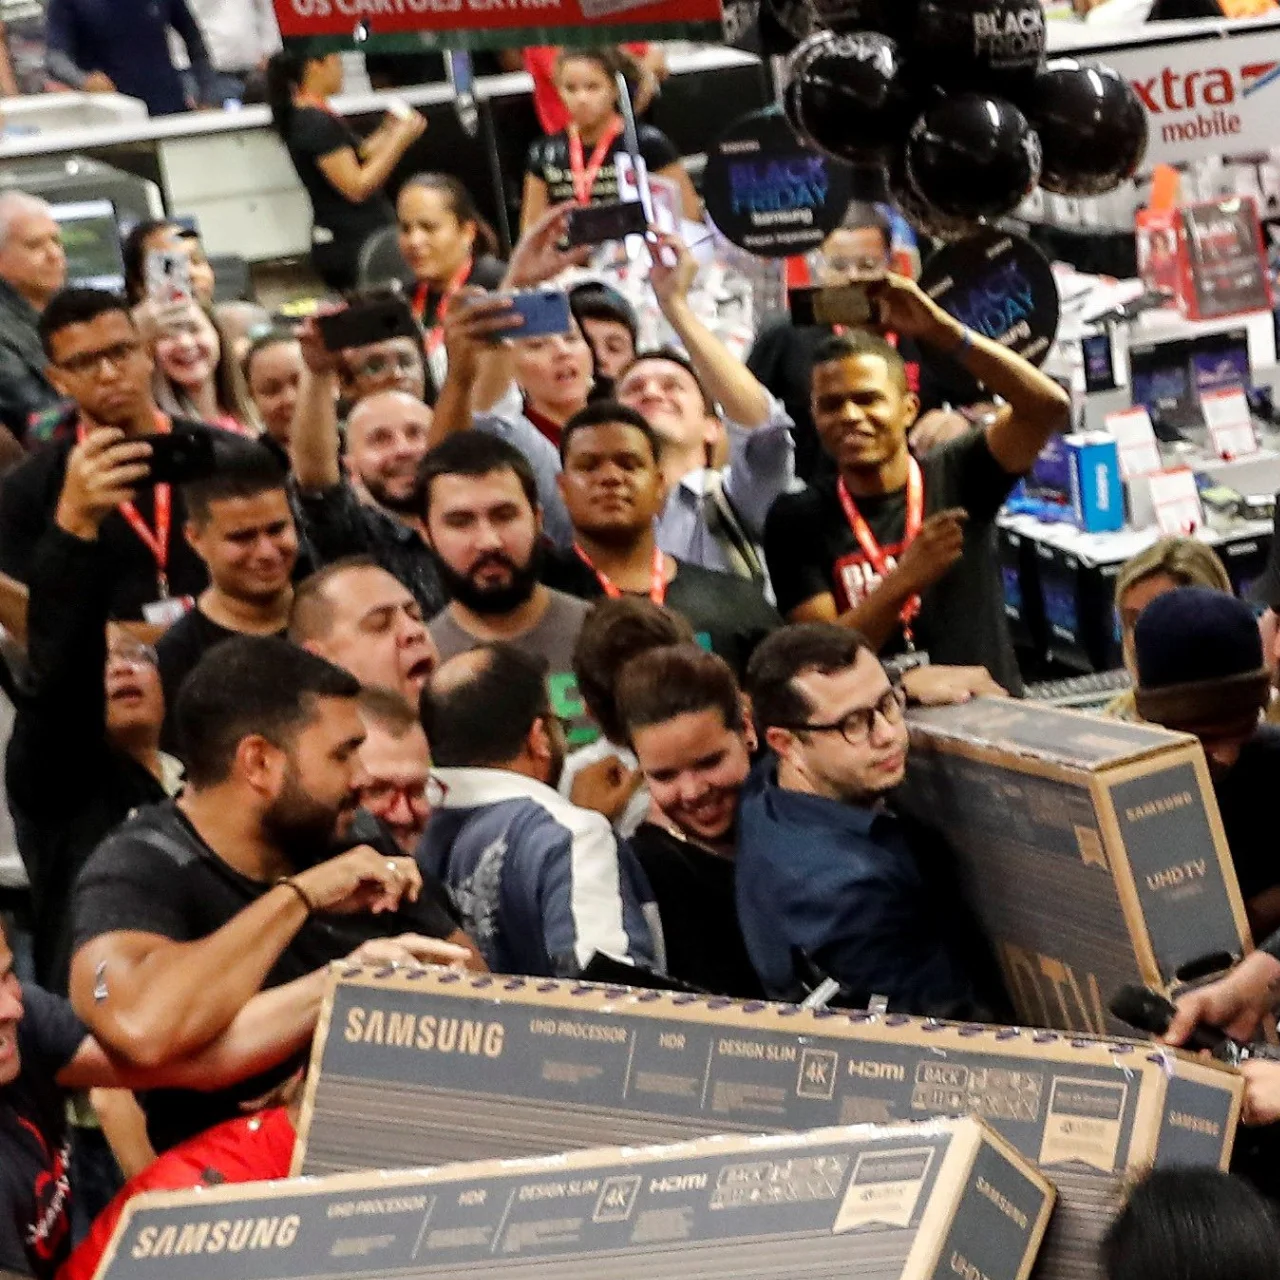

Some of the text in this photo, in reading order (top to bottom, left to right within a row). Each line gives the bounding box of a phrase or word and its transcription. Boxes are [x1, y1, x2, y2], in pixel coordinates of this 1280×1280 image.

[1131, 65, 1235, 114] xtra
[1161, 110, 1241, 145] mobile
[1126, 791, 1194, 822] SAMSUNG
[343, 1006, 505, 1058] SAMSUNG
[529, 1018, 628, 1044] UHD PROCESSOR
[659, 1032, 686, 1050] HDR
[718, 1038, 797, 1062] DESIGN SLIM
[805, 1061, 828, 1084] 4K
[131, 1212, 301, 1261] SAMSUNG
